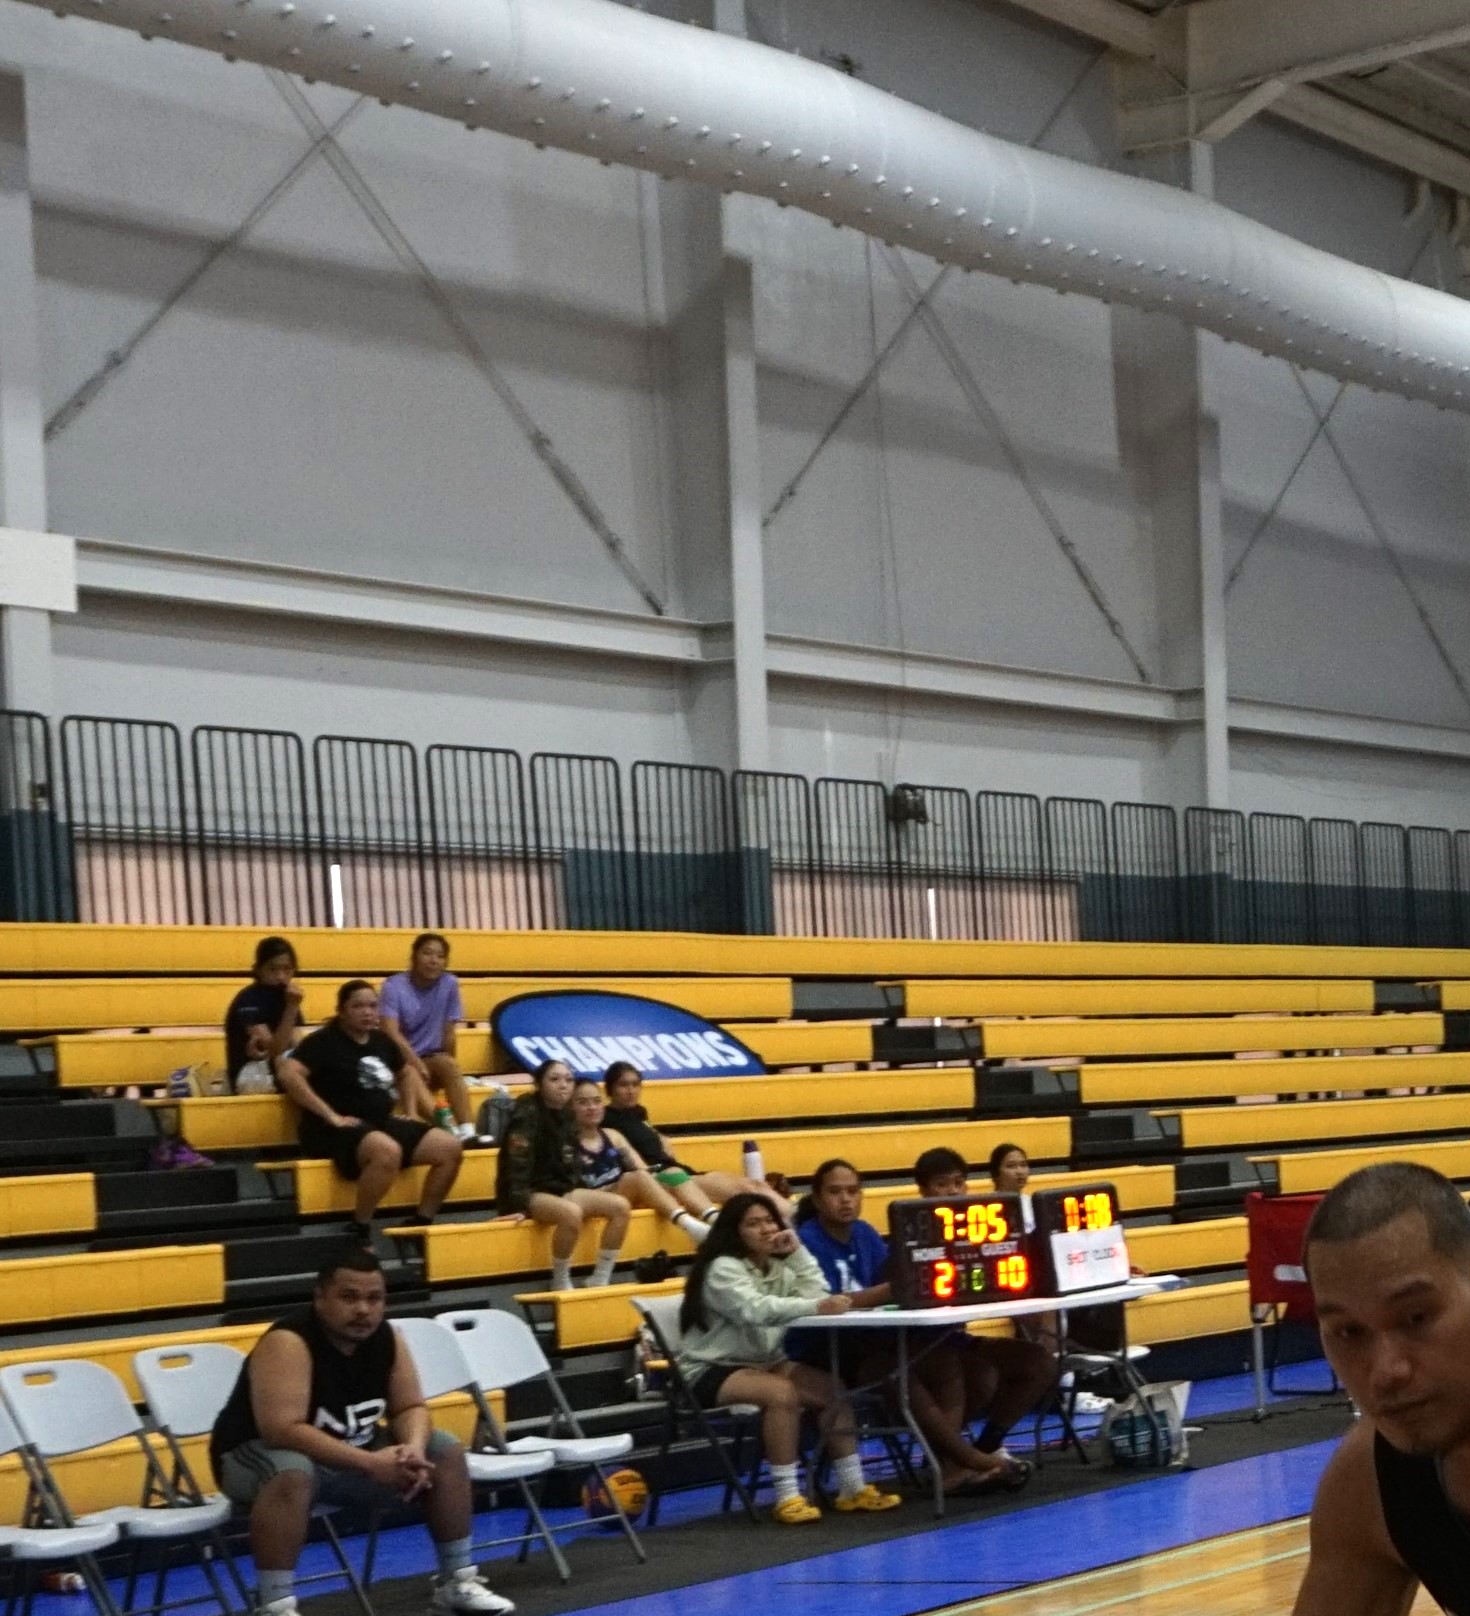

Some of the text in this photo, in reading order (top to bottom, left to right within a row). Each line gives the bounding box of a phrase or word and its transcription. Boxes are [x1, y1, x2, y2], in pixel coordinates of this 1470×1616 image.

[511, 1030, 749, 1073] CHAMPIONS
[934, 1203, 1008, 1244] 7:05
[934, 1261, 955, 1297] 2
[997, 1254, 1029, 1289] 10
